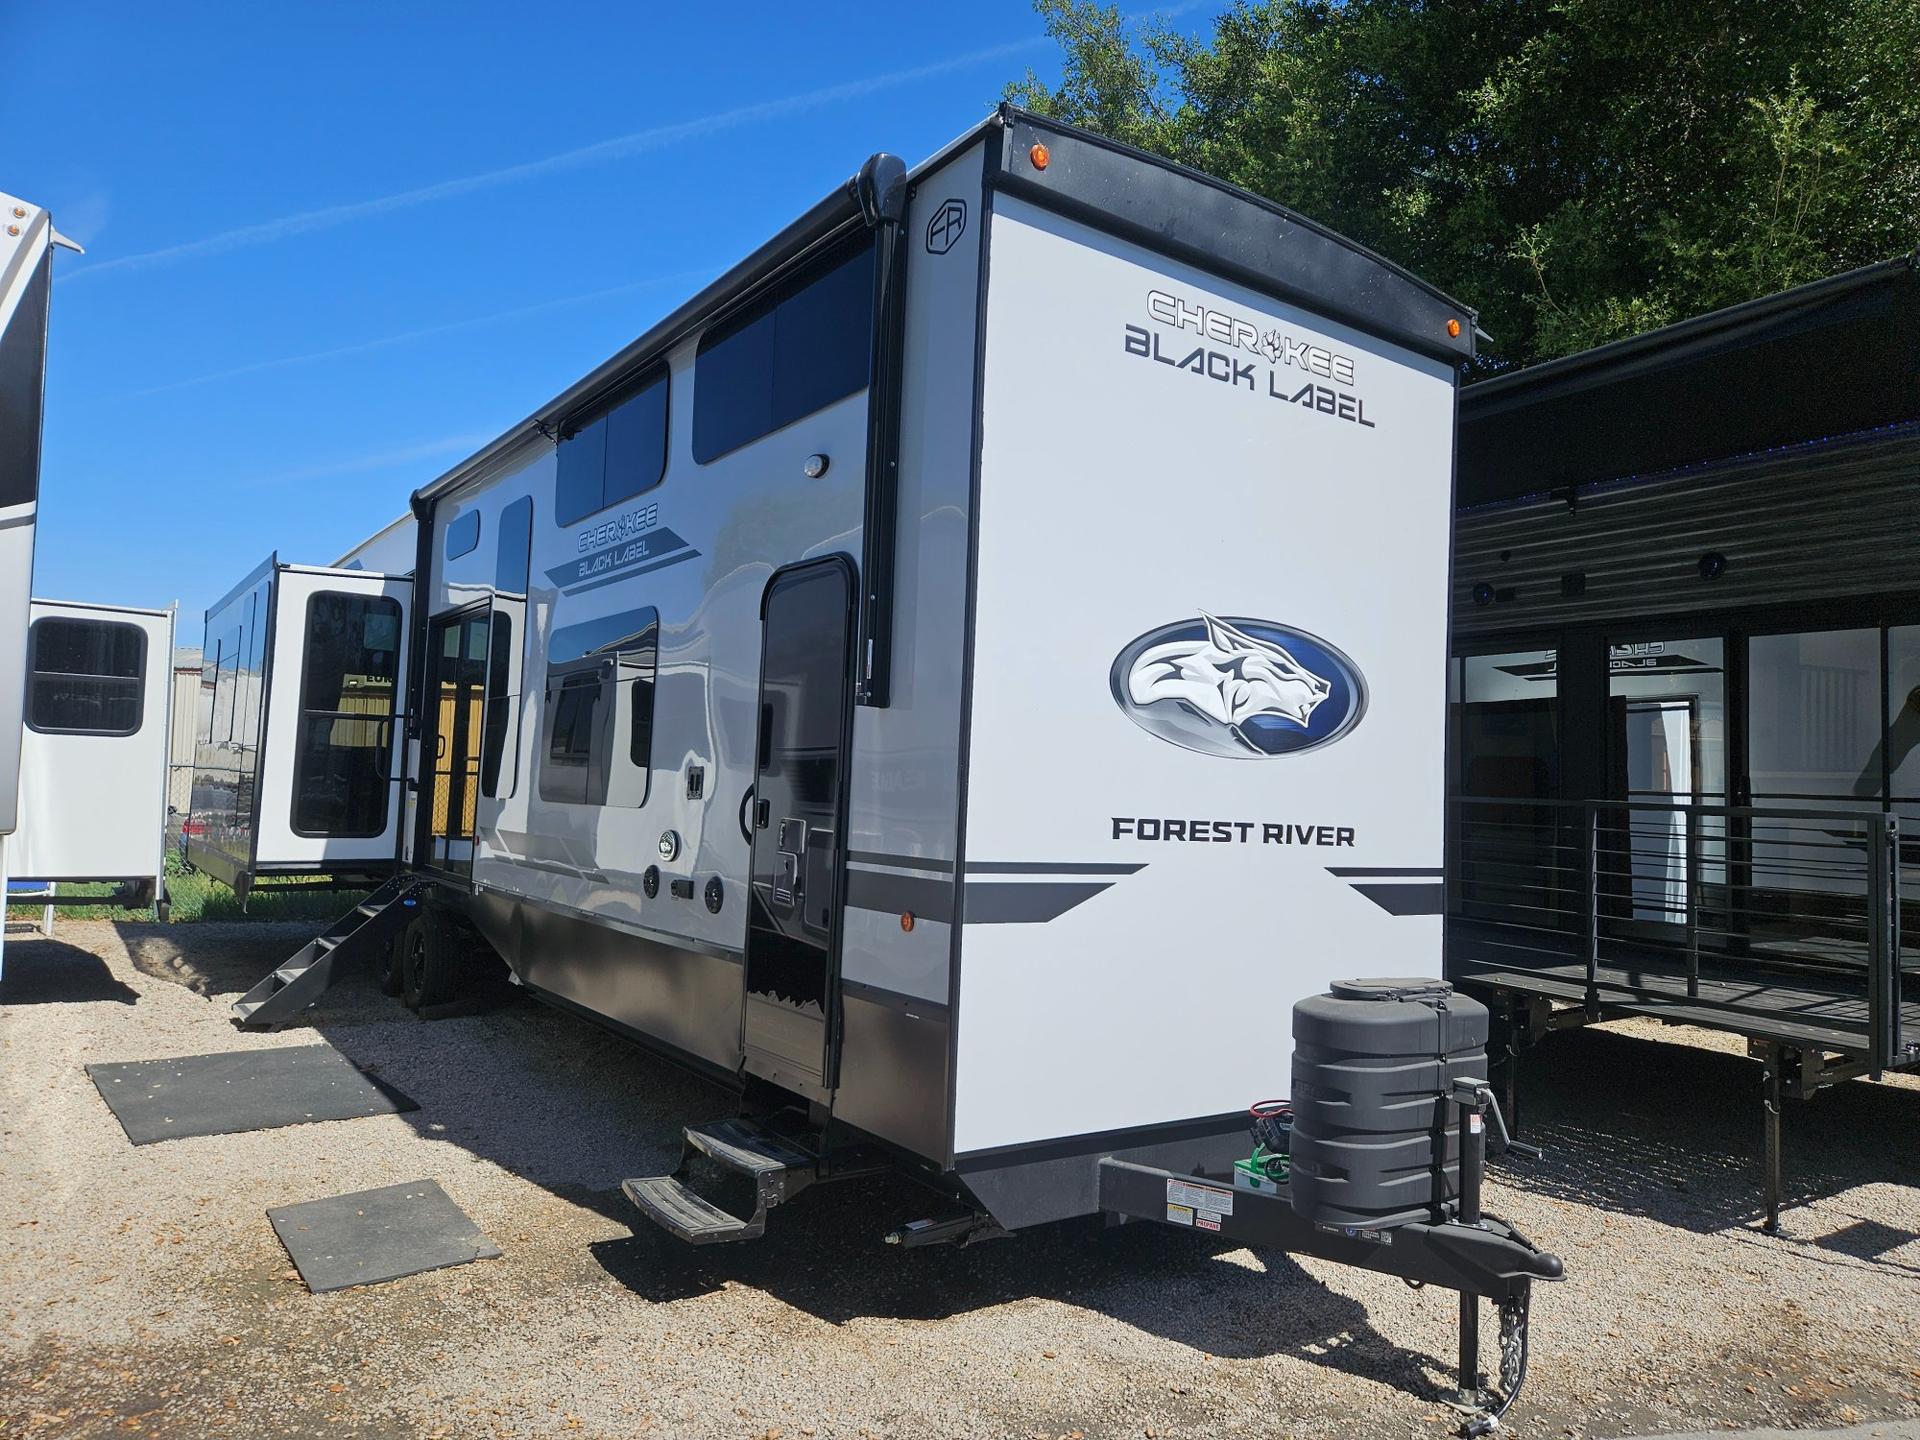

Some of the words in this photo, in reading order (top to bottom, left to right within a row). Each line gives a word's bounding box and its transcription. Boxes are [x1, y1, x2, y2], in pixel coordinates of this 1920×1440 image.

[1146, 289, 1355, 387] CHEROKEE
[1124, 322, 1257, 392] BLACK
[1268, 369, 1377, 429] LABEL
[578, 502, 658, 553] CHEROKEE
[578, 552, 612, 577] BLACK
[614, 540, 650, 565] LABEL
[1110, 816, 1255, 844] FOREST
[1261, 822, 1356, 848] RIVER
